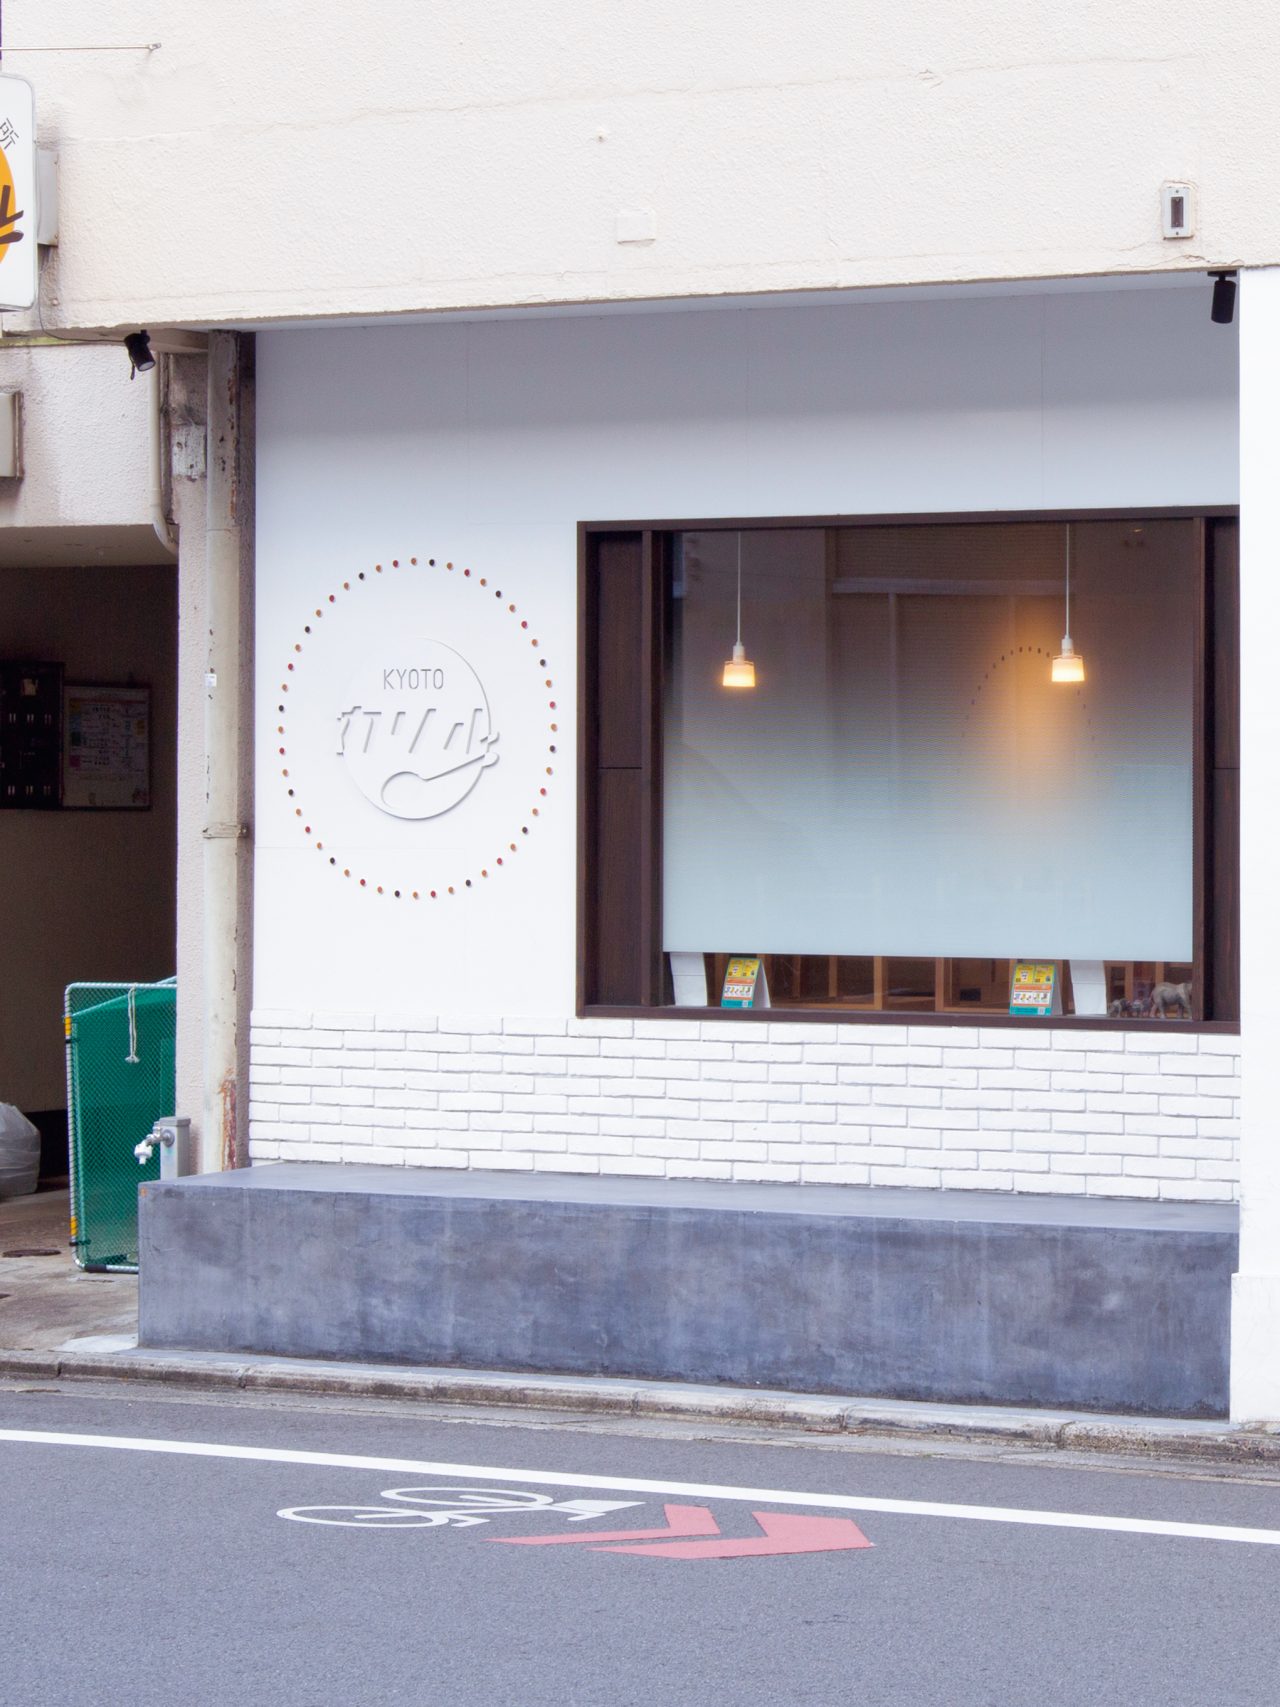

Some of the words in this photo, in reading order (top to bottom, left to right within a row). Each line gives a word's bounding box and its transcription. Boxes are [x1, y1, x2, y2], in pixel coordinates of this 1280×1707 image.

[383, 668, 444, 690] KYOTO
[336, 705, 500, 755] カリル
